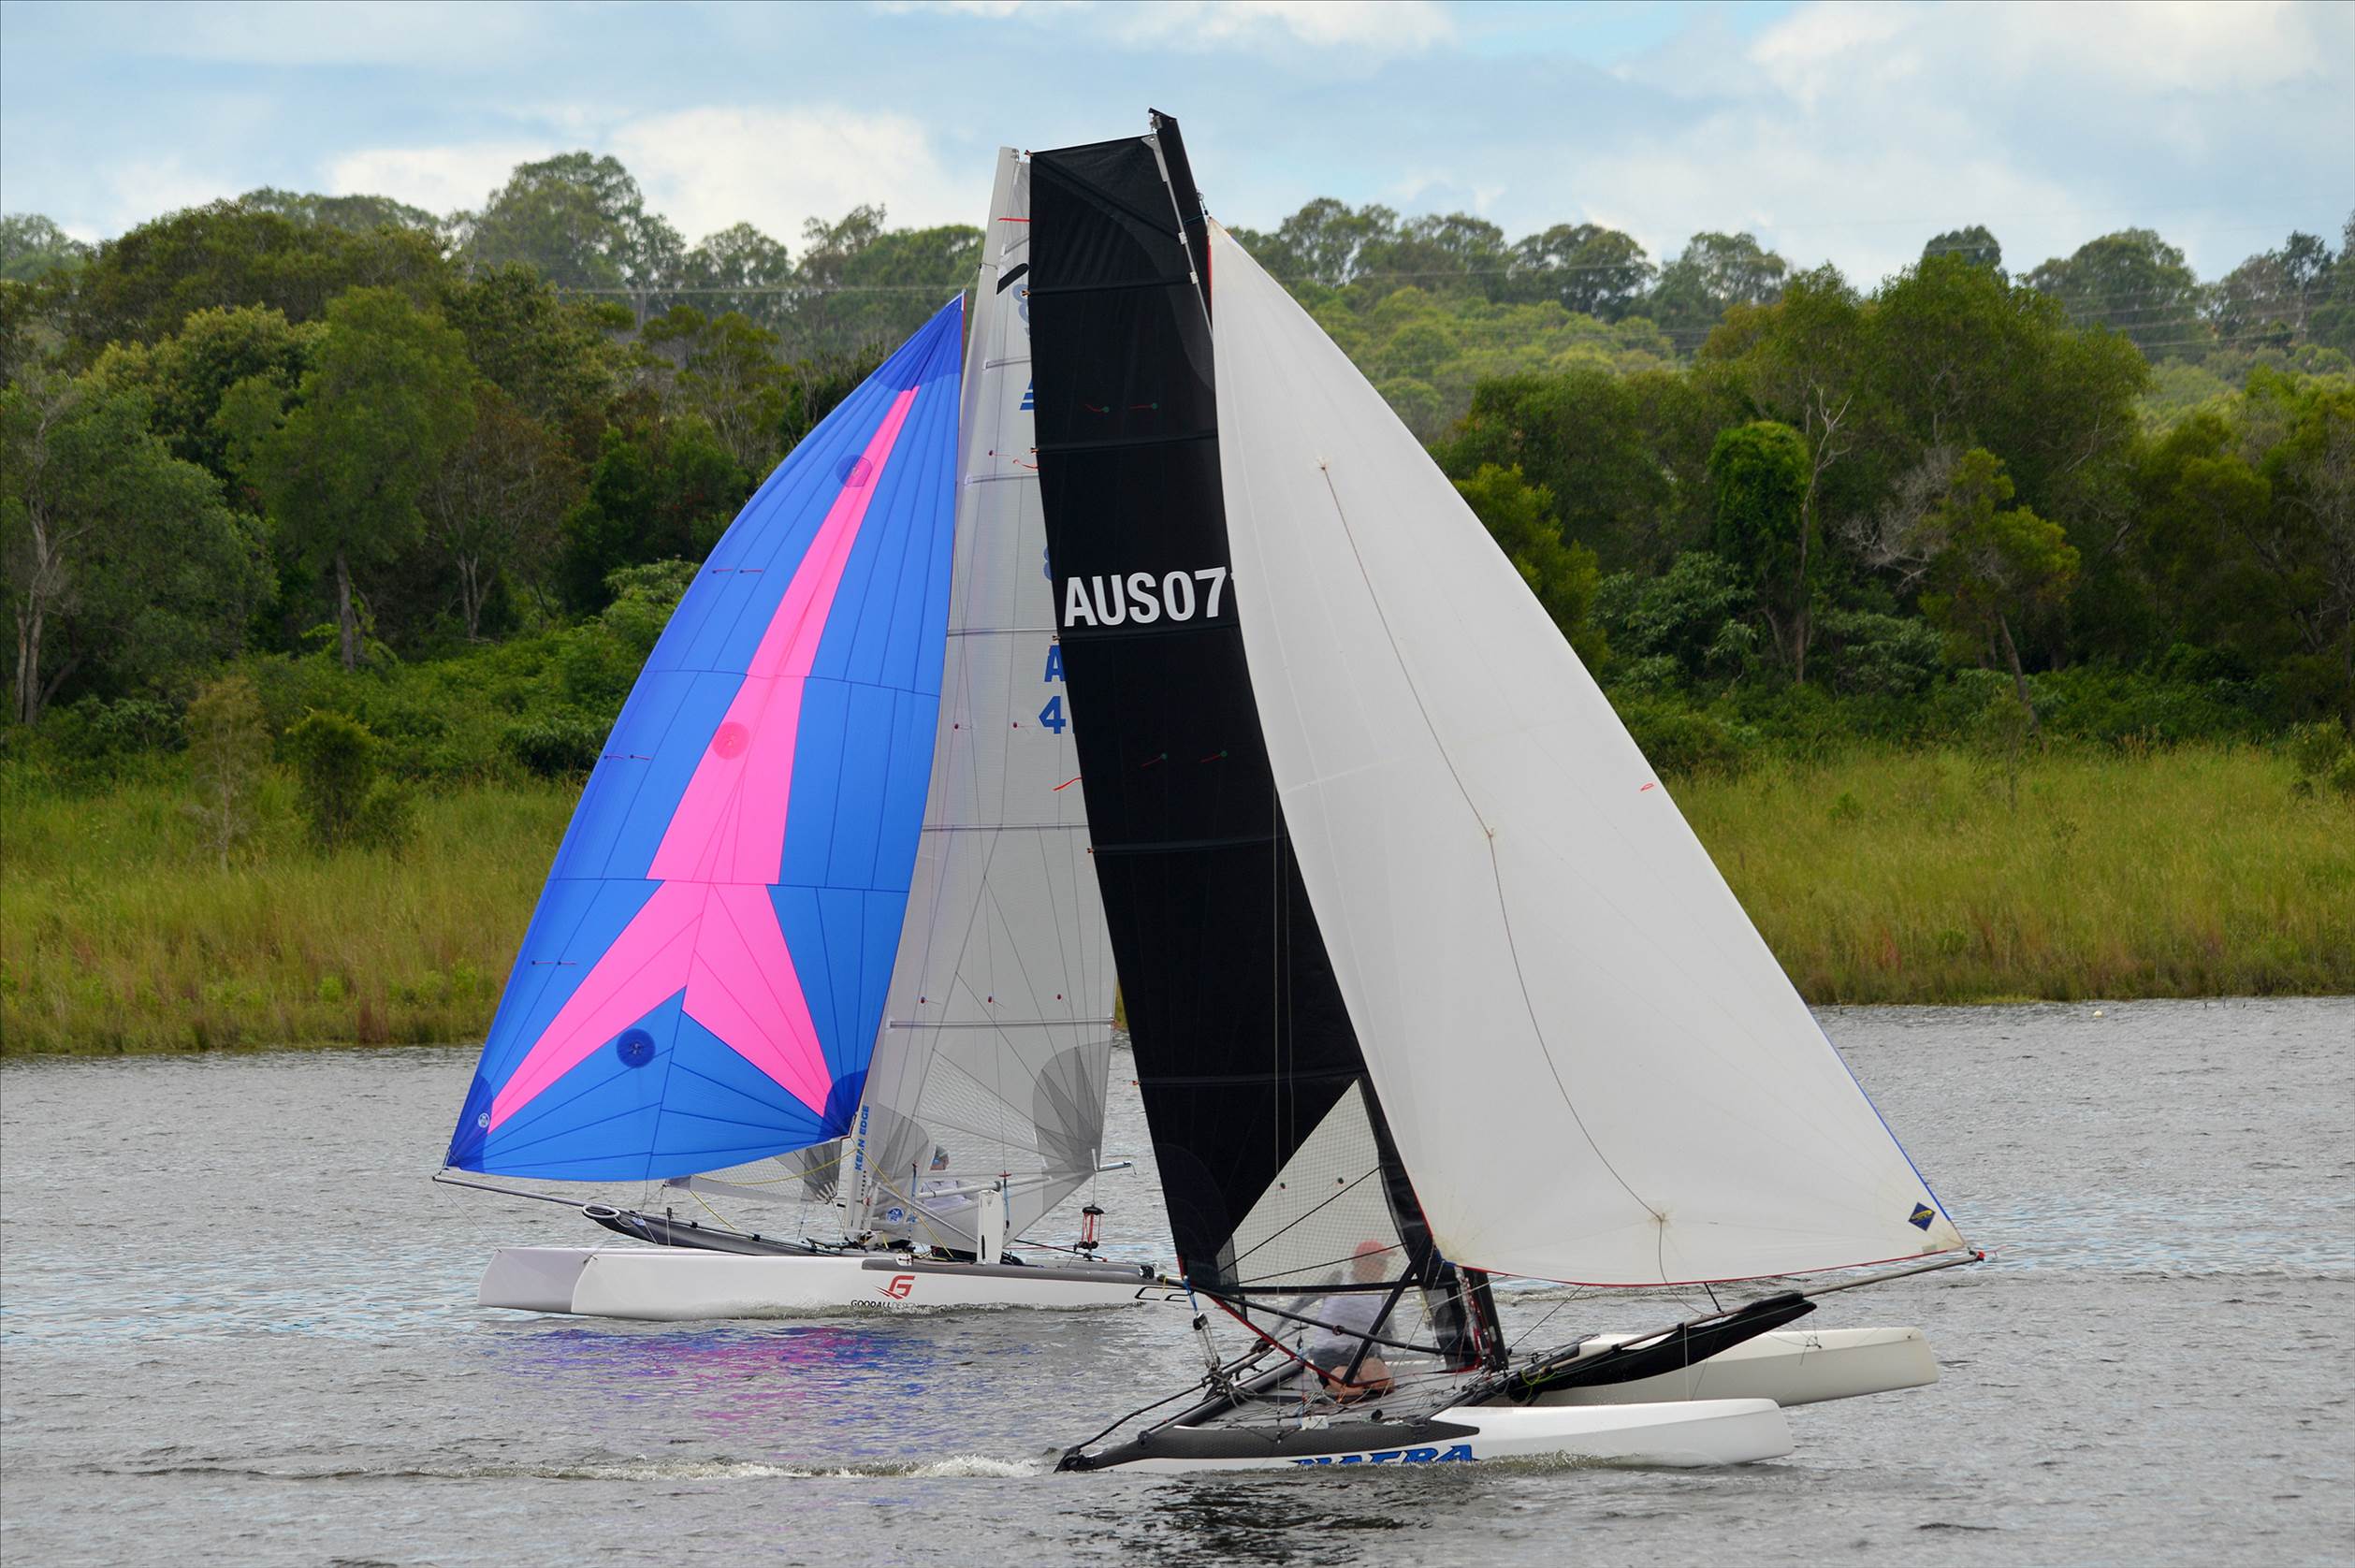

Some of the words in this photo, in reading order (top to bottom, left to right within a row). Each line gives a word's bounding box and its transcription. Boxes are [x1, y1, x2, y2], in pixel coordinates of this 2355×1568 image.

[1064, 567, 1233, 627] AUS07
[1039, 696, 1075, 734] 4
[859, 1104, 869, 1136] EDGE
